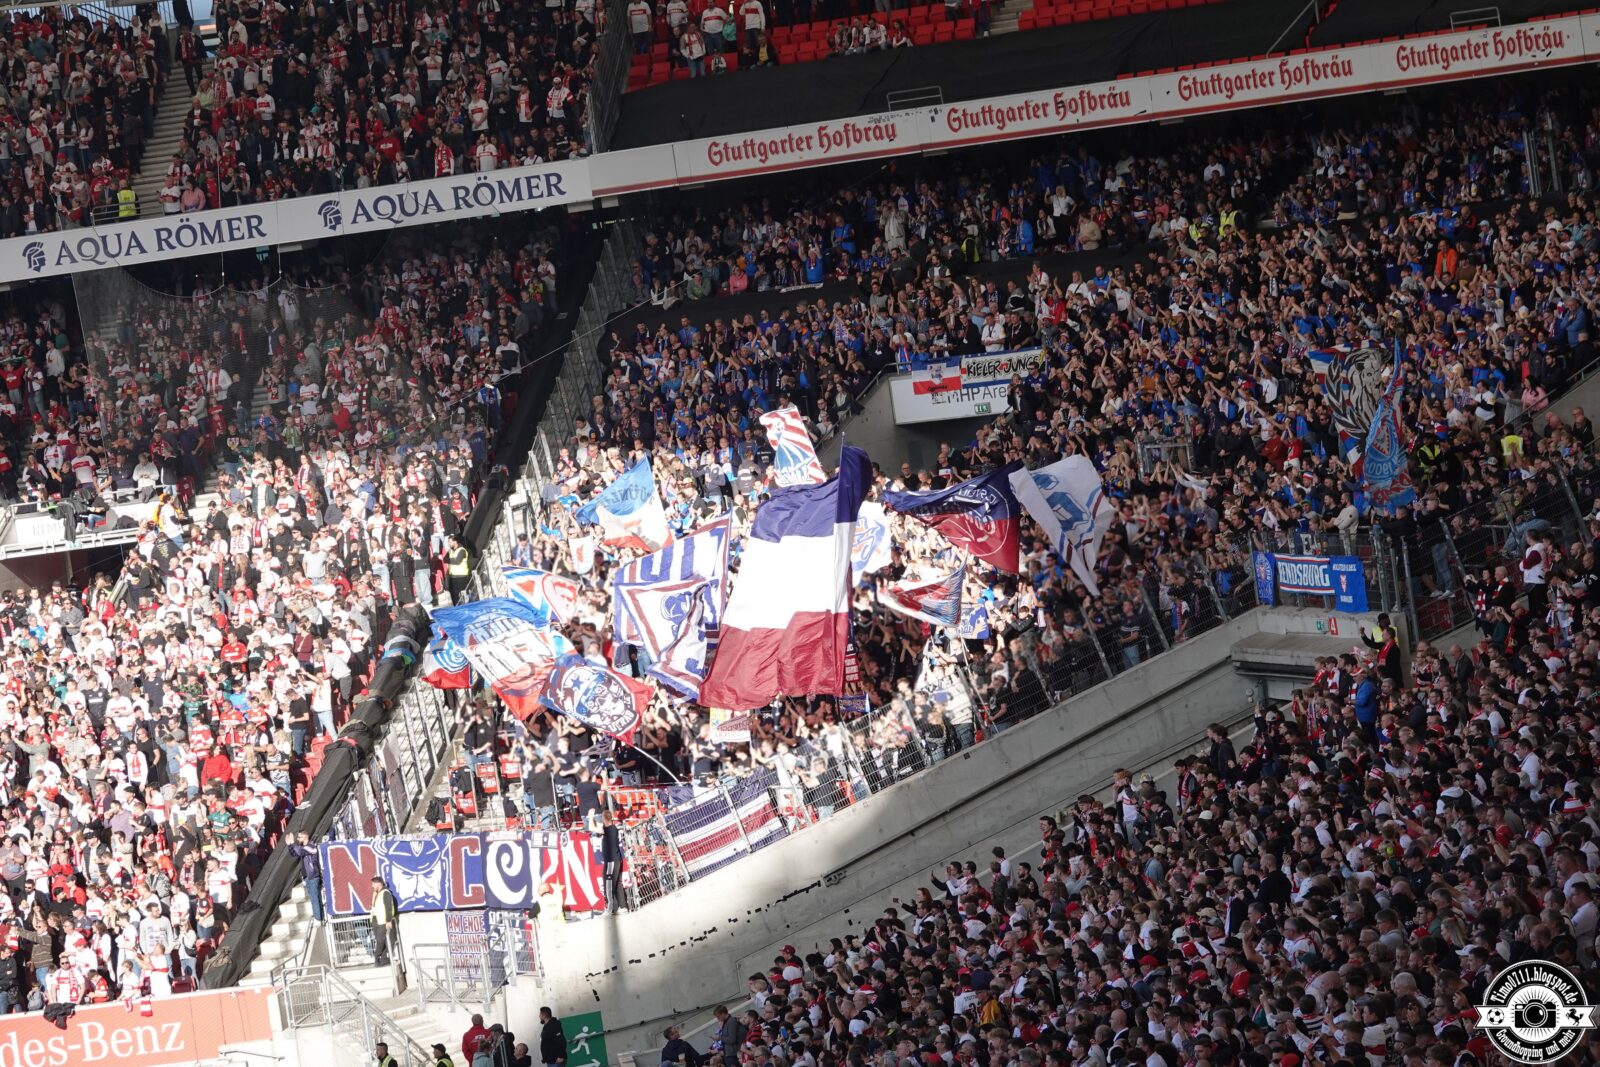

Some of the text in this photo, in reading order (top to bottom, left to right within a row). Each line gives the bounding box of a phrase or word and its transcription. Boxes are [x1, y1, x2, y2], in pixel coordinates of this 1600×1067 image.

[1395, 26, 1566, 72] Stuttgarter Hofbräu
[1178, 55, 1354, 101] Stuttgarter Hofbräu
[946, 86, 1132, 133] Stuttgarter Hofbräu
[707, 129, 814, 167] Stuttgarter
[350, 172, 567, 225] AQUA RÖMER
[54, 214, 267, 266] AQUA RÖMER
